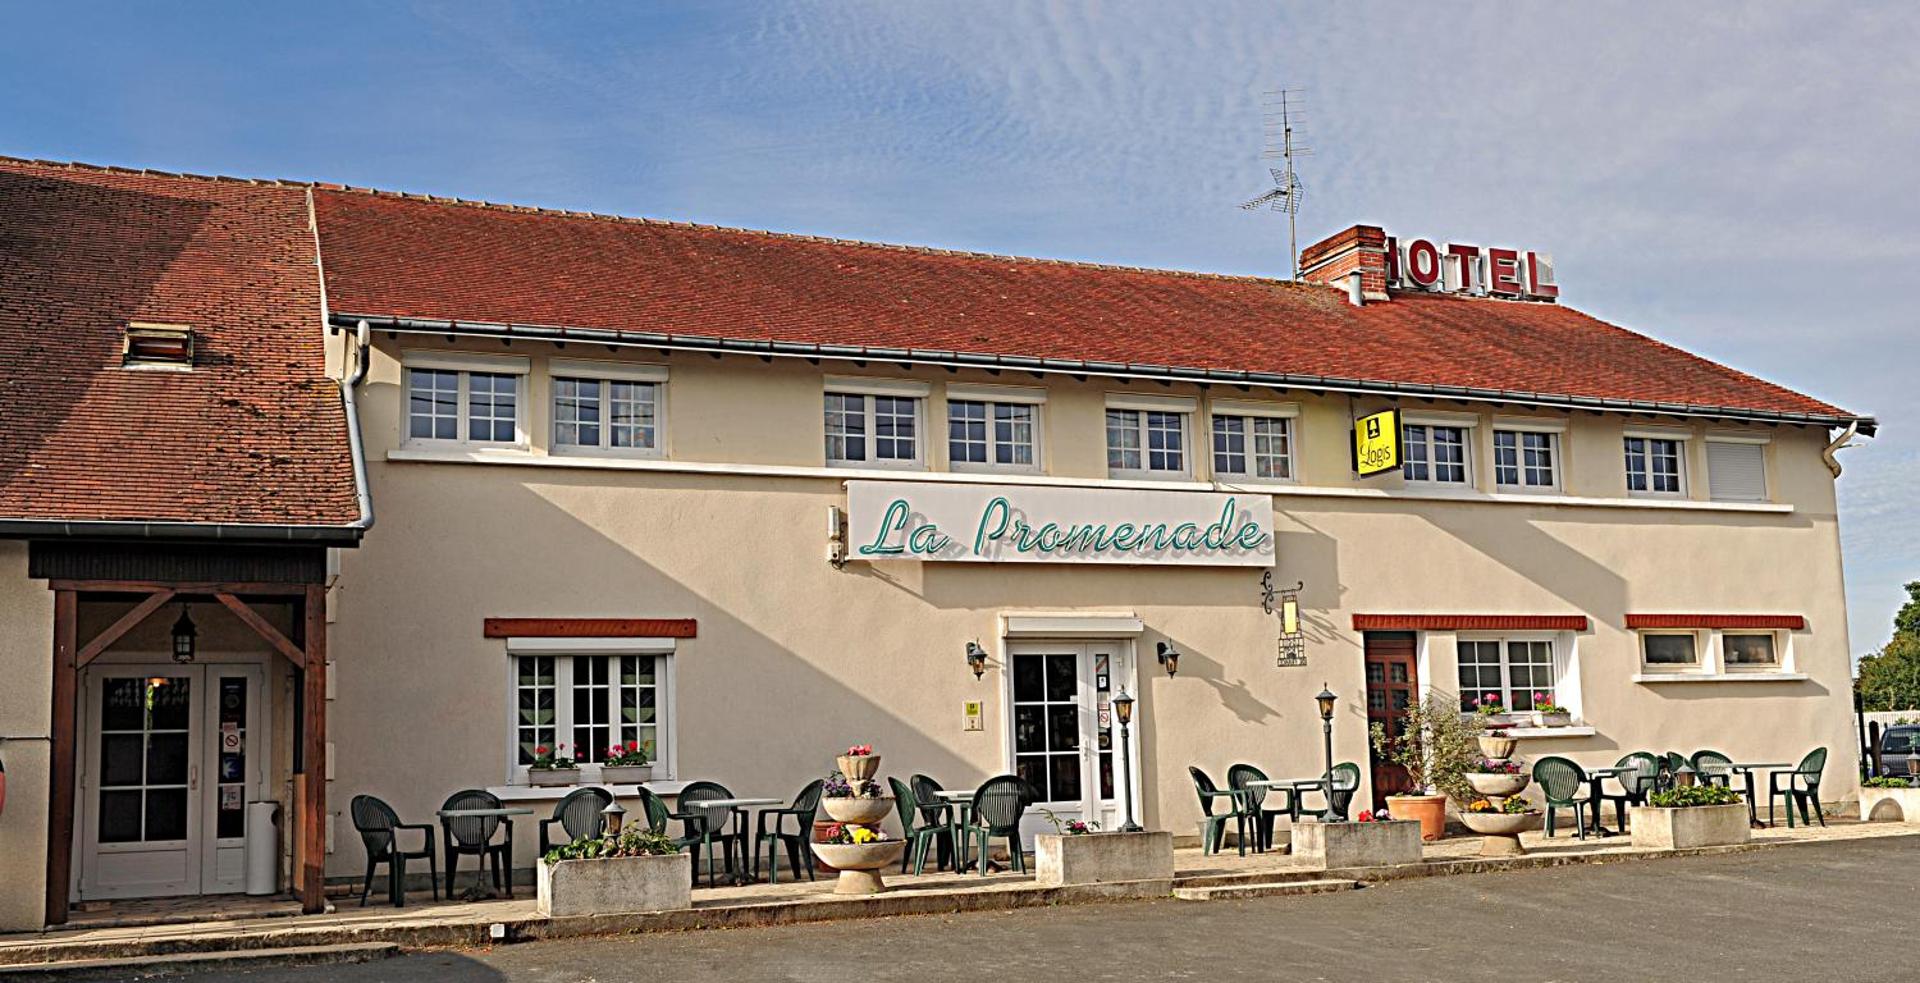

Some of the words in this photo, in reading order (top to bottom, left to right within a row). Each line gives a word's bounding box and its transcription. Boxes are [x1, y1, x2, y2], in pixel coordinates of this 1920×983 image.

[1360, 441, 1391, 468] Logis
[859, 499, 951, 555] La
[973, 496, 1269, 555] Promenade
